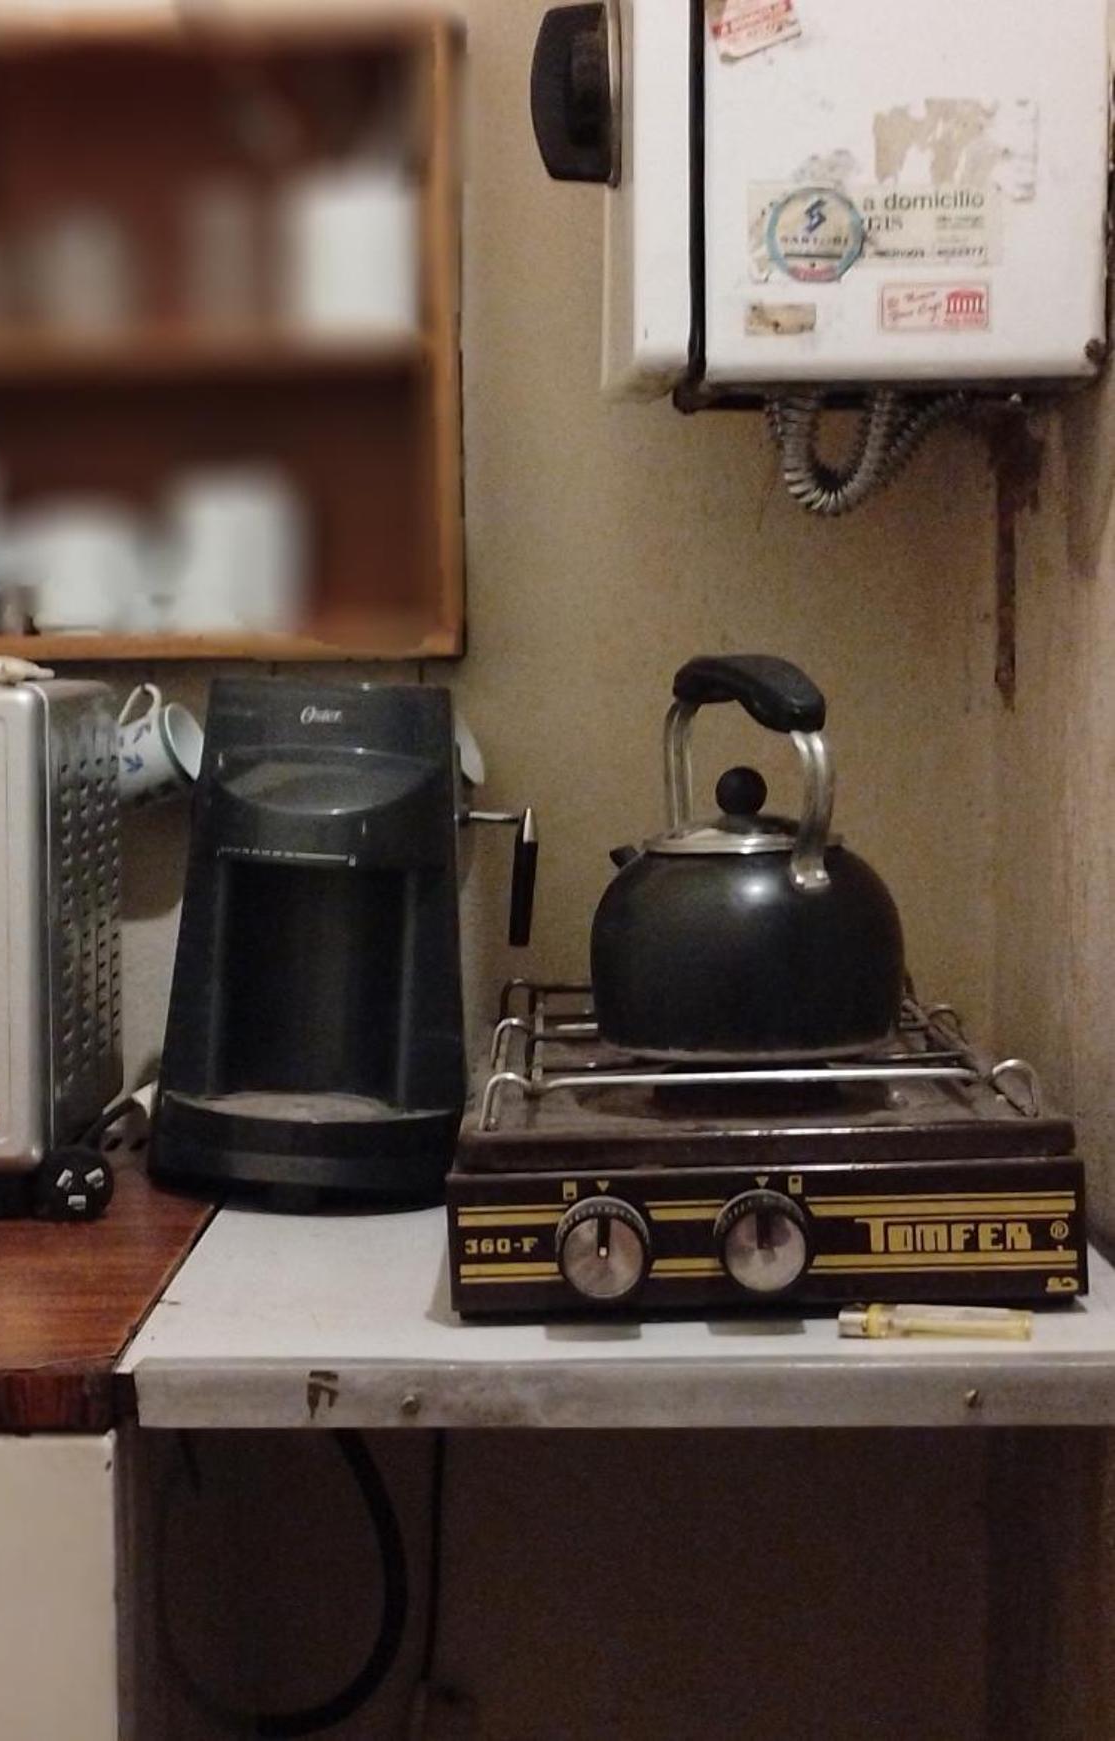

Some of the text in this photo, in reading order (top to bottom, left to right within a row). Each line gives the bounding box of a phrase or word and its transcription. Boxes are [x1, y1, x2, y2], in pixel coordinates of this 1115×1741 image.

[884, 191, 985, 211] domicilio
[855, 1215, 1032, 1252] TOMFER
[464, 1236, 538, 1255] 360-F
